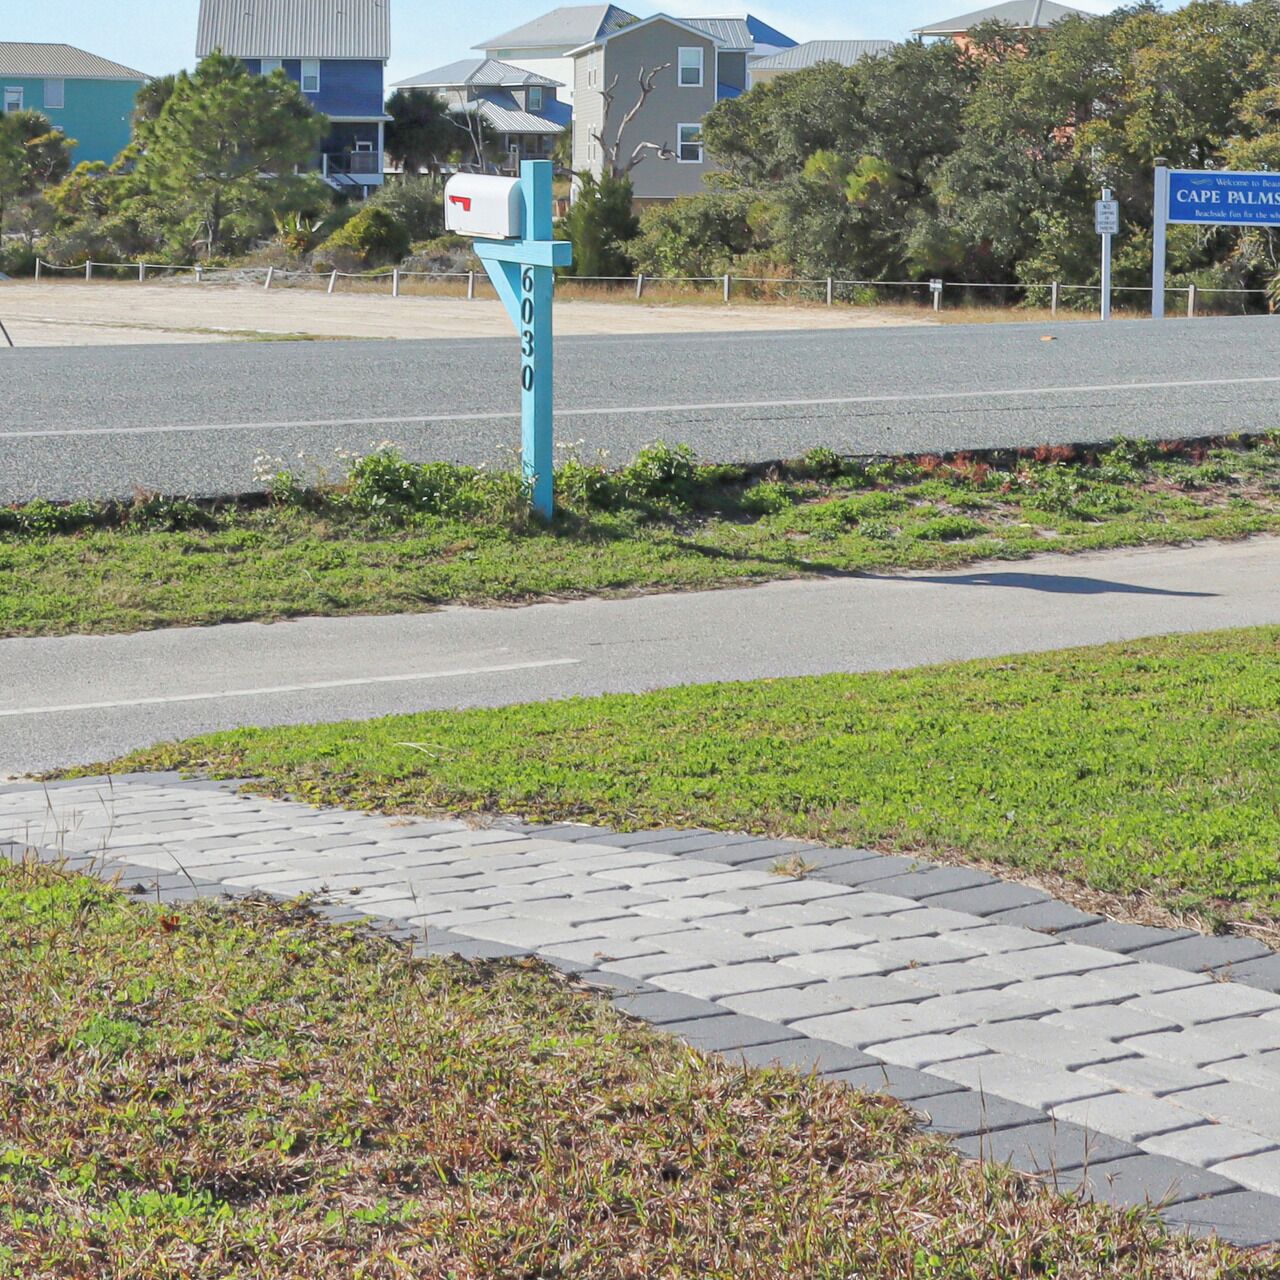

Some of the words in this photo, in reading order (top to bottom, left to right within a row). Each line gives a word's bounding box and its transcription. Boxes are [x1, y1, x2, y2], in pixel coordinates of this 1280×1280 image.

[1216, 178, 1249, 187] Welcome
[1176, 189, 1221, 203] CAPE
[1195, 210, 1227, 218] Beachside
[1229, 210, 1242, 218] fun
[1244, 210, 1253, 218] for
[1256, 211, 1268, 219] the
[522, 267, 533, 392] 6030
